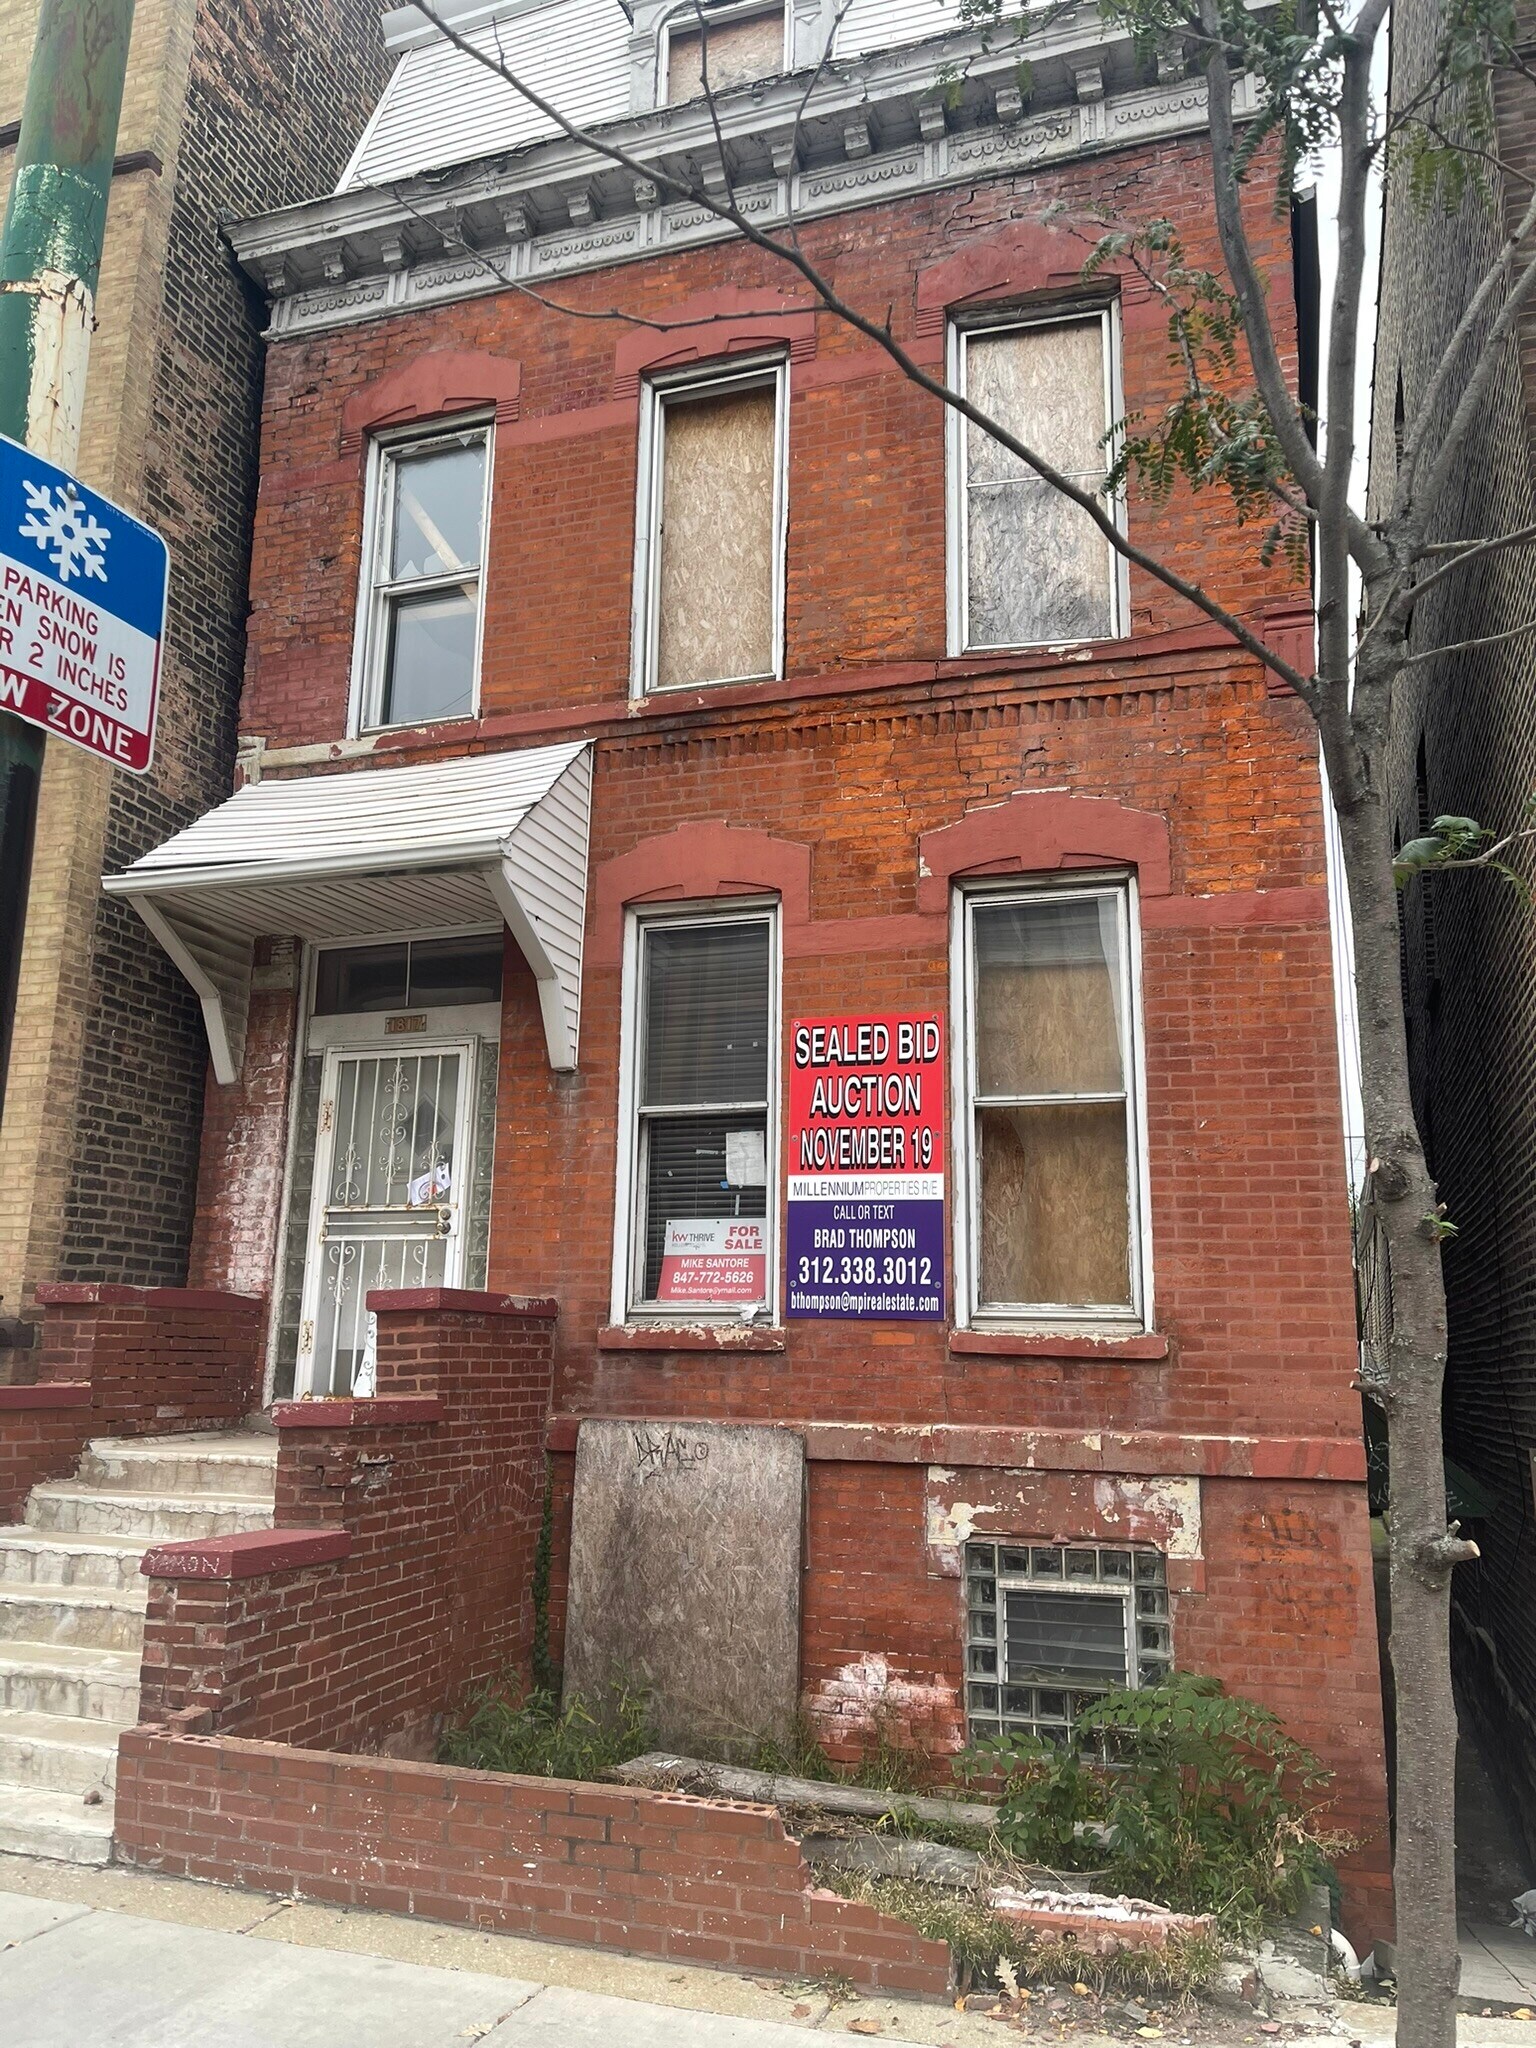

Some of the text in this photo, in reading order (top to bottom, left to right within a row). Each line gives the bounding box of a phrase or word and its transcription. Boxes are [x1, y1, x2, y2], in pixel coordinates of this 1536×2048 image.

[105, 504, 120, 516] CITY
[132, 522, 160, 543] CHICAGO
[4, 566, 98, 636] PARKING
[37, 615, 97, 665] SNOW
[108, 652, 125, 680] IS
[28, 641, 43, 668] 2
[57, 655, 128, 711] INCHES
[48, 692, 133, 761] ZONE
[794, 1021, 940, 1069] SEALED BID
[809, 1073, 921, 1119] AUCTION
[800, 1126, 905, 1171] NOVEMBER
[911, 1126, 933, 1169] 19
[833, 1204, 895, 1220] CALL OR TEXT
[689, 1232, 715, 1242] THRIVE
[724, 1239, 763, 1250] SALE
[729, 1226, 760, 1237] FOR
[814, 1228, 916, 1249] BRAD THOMPSON
[672, 1271, 754, 1284] 847-772-5626
[681, 1258, 749, 1268] MIKE SANTORE
[798, 1256, 932, 1285] 312.338.3012
[791, 1291, 939, 1314] bthompson@mpirealestate.com
